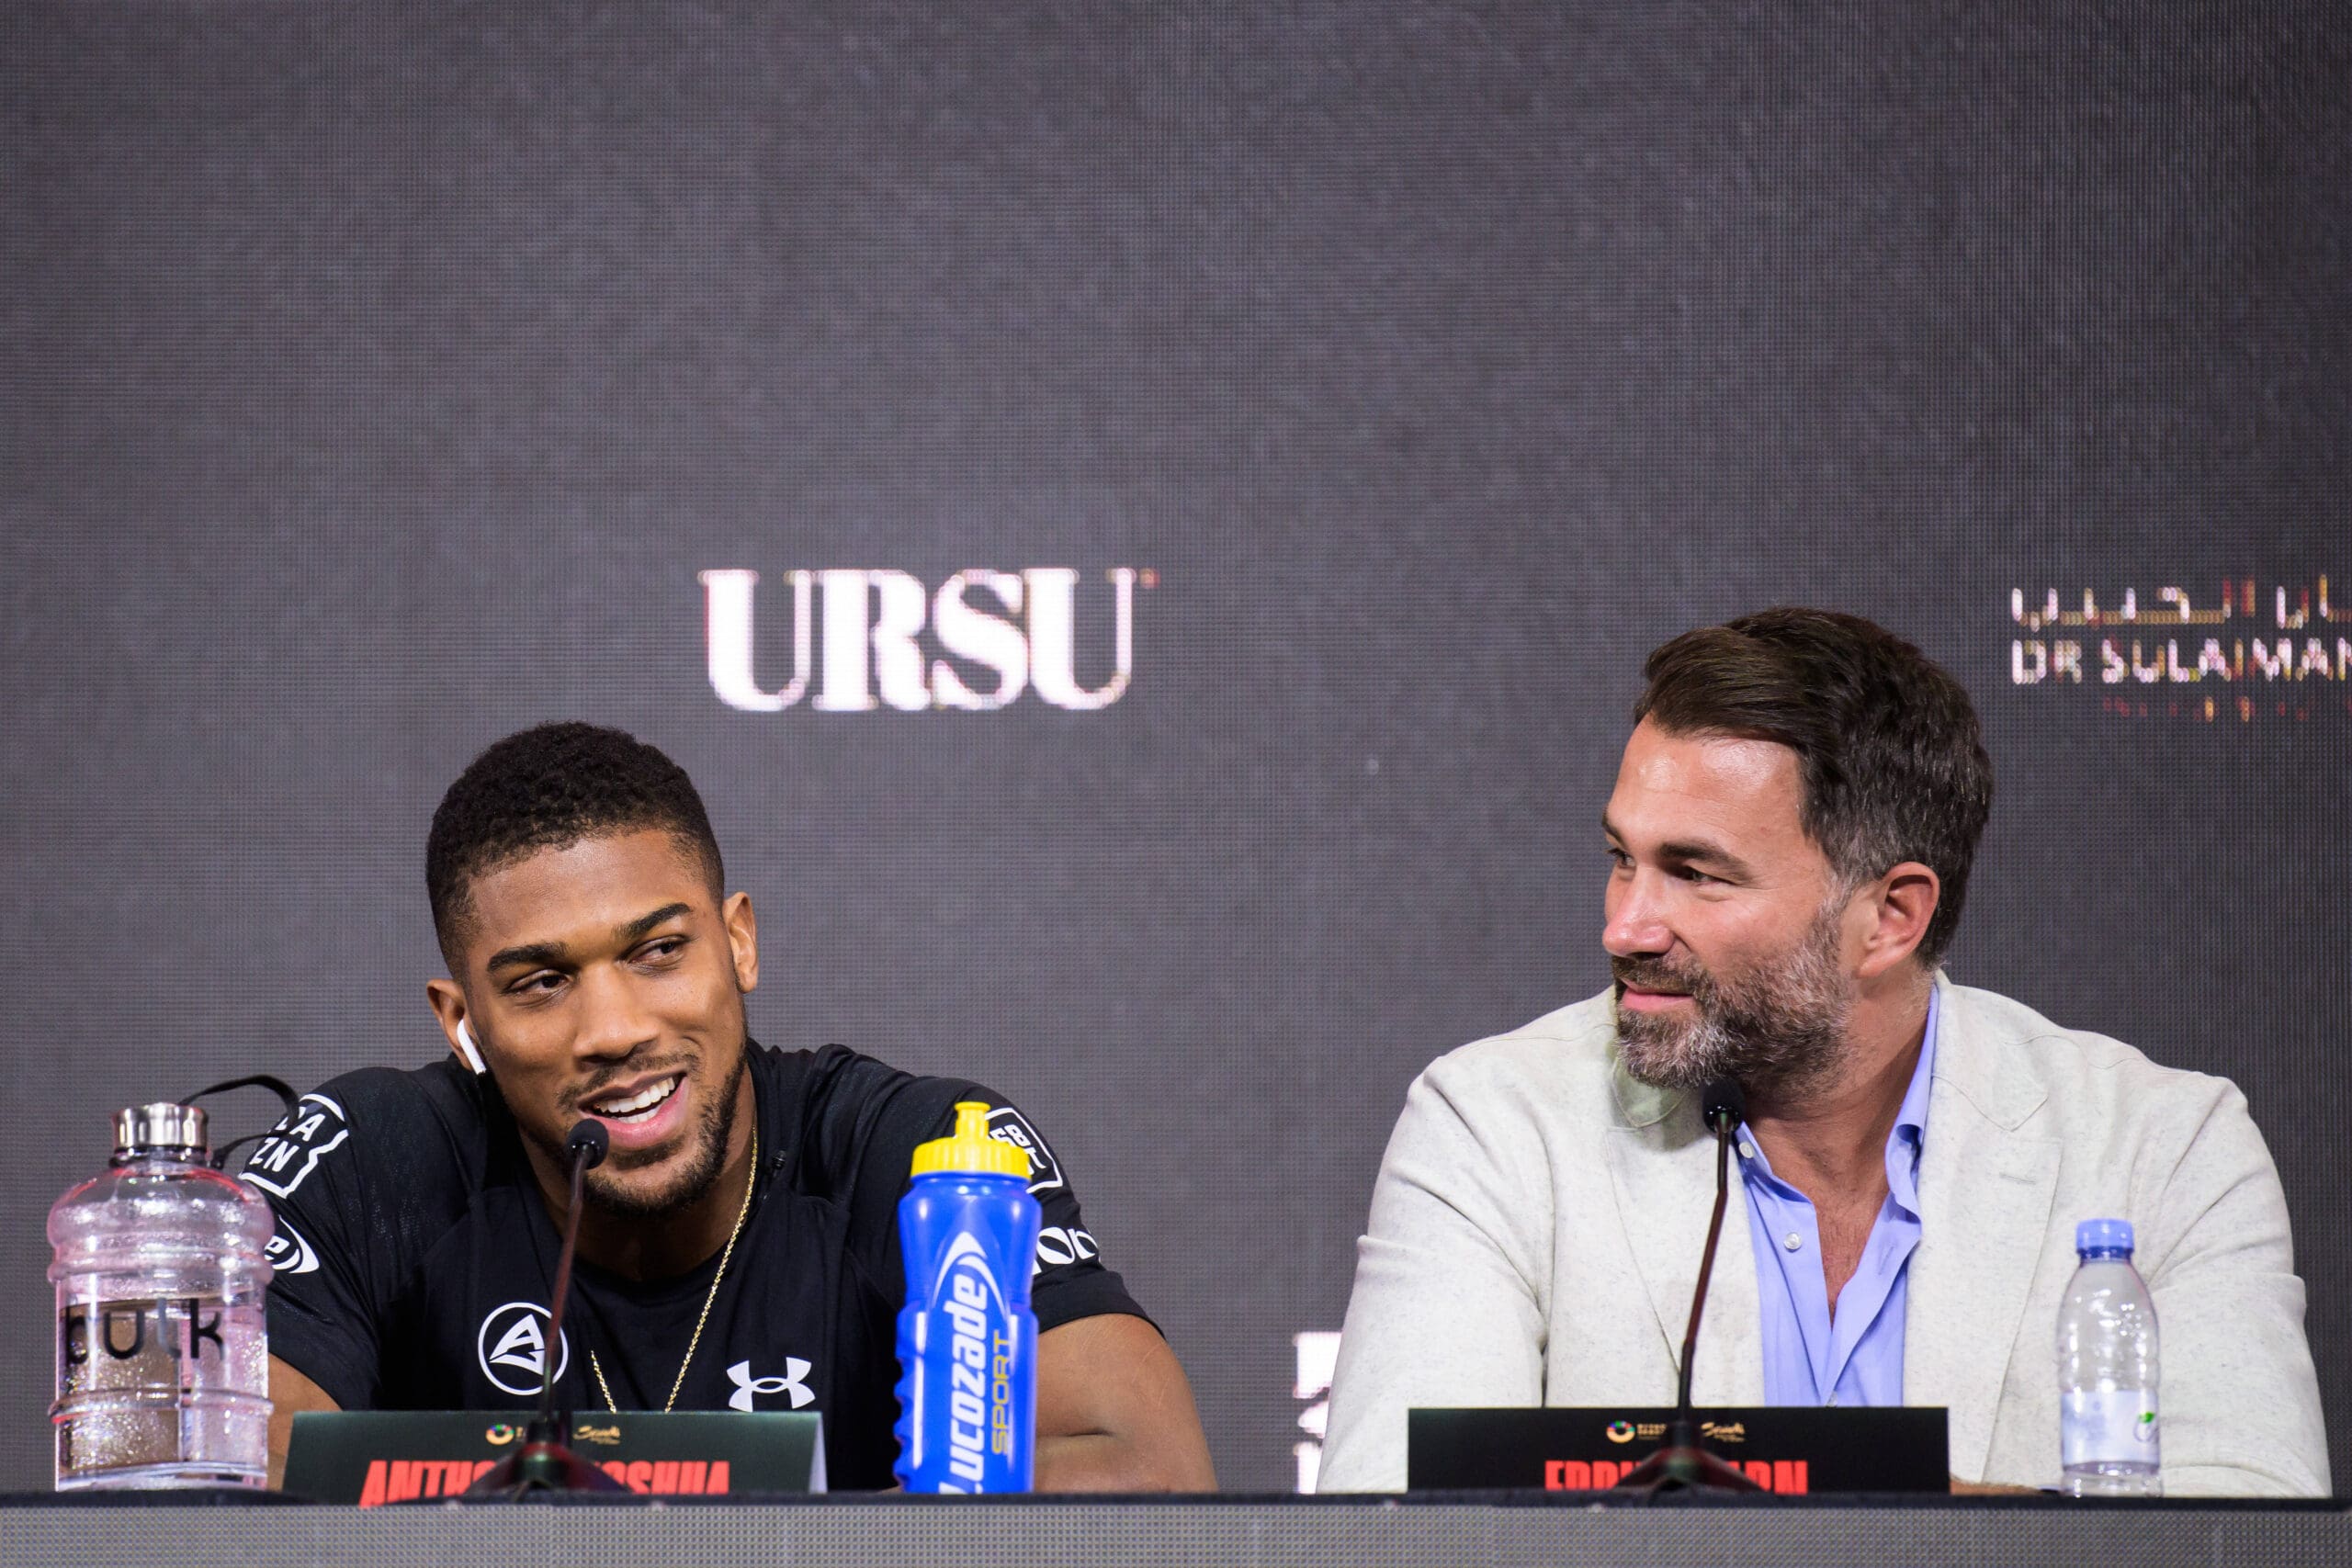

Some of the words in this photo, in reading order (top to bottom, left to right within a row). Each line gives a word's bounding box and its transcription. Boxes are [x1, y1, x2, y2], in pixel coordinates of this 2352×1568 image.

[697, 568, 1135, 712] URSU
[2012, 638, 2082, 684] DR
[992, 1328, 1010, 1456] SPORT
[358, 1460, 497, 1508] ANTH
[594, 1460, 730, 1495] OSHUA
